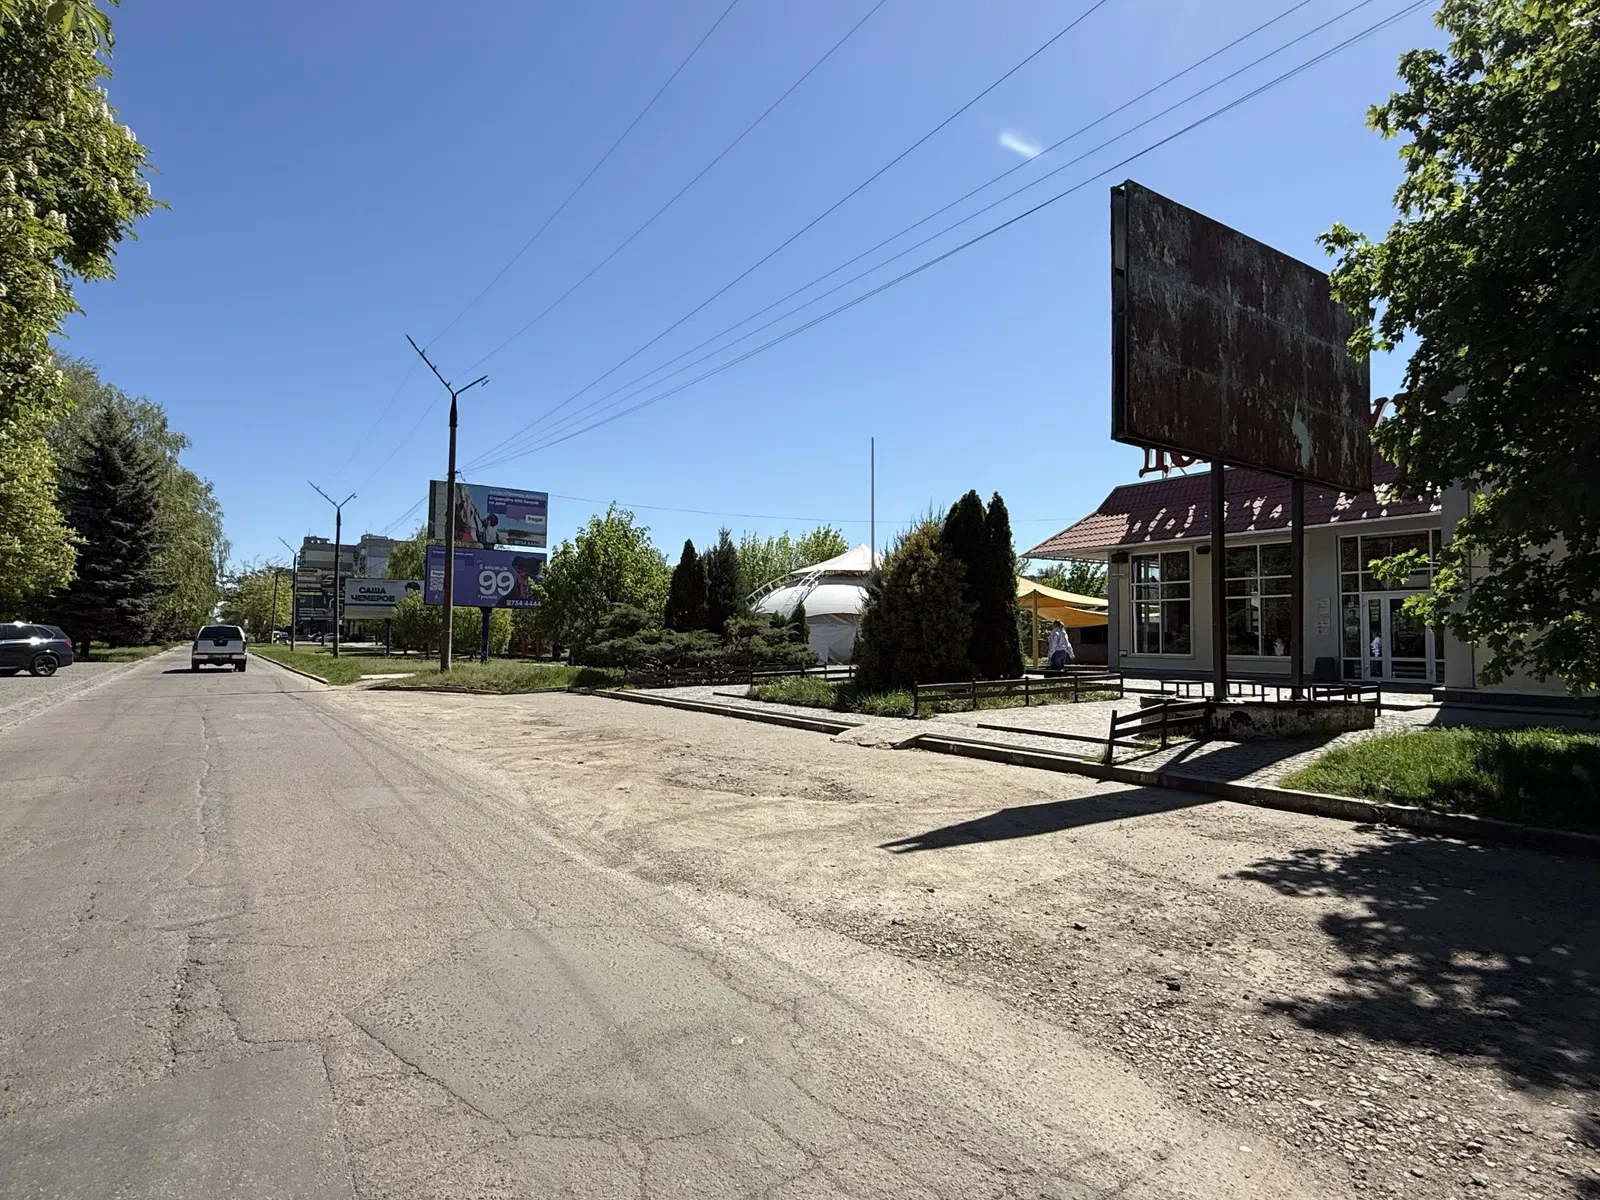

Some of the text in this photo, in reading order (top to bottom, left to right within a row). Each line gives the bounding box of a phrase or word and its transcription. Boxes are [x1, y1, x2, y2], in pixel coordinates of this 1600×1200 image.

[479, 570, 515, 596] 99
[358, 586, 387, 594] САША
[350, 594, 396, 603] ЧЕМЕРОВ
